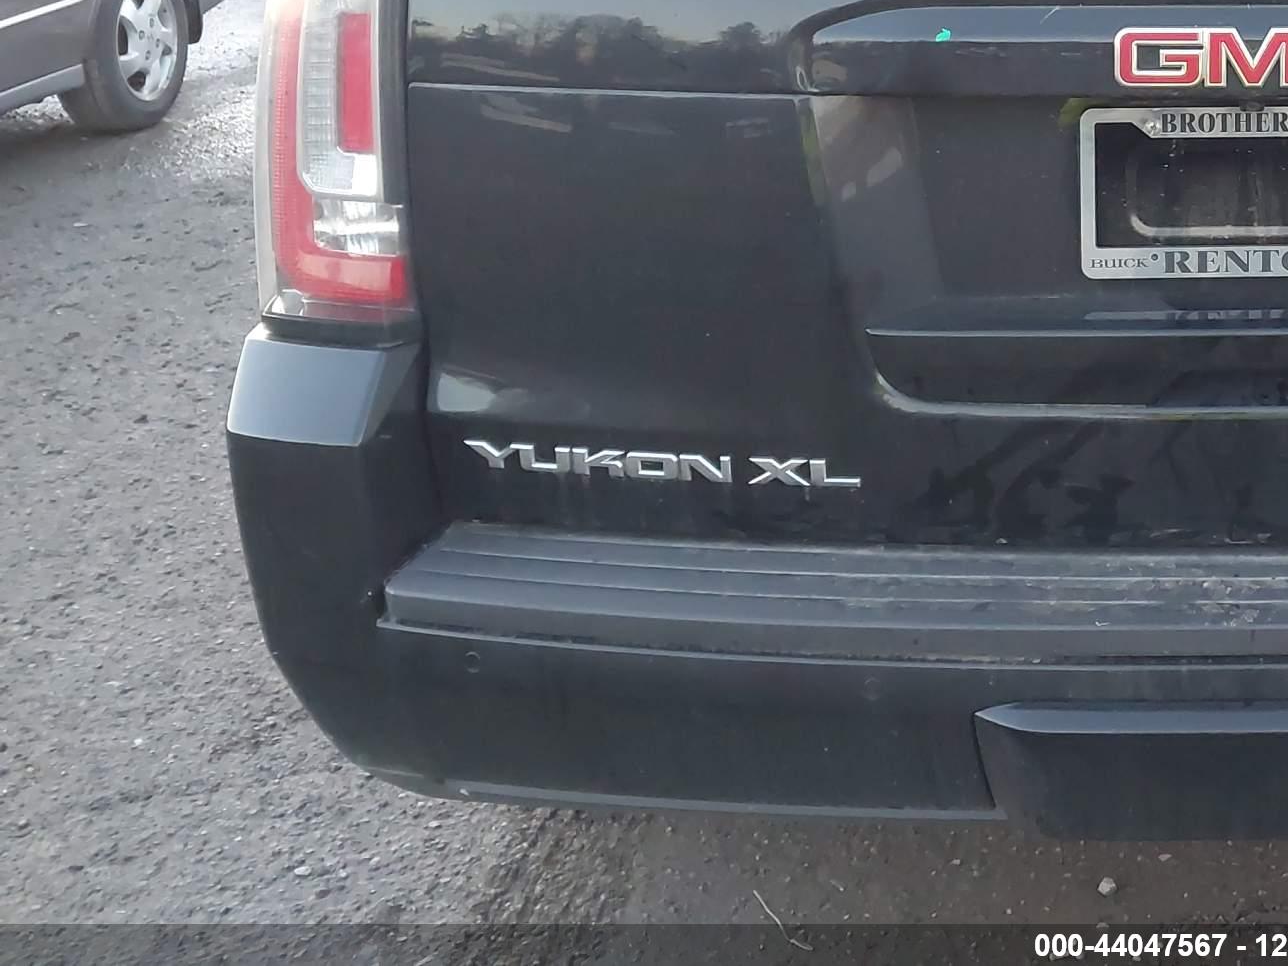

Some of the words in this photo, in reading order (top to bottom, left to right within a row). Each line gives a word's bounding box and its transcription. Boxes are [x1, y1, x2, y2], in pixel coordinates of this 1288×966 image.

[1088, 258, 1148, 269] BUICK
[463, 439, 732, 482] YUKON
[748, 457, 861, 487] XL
